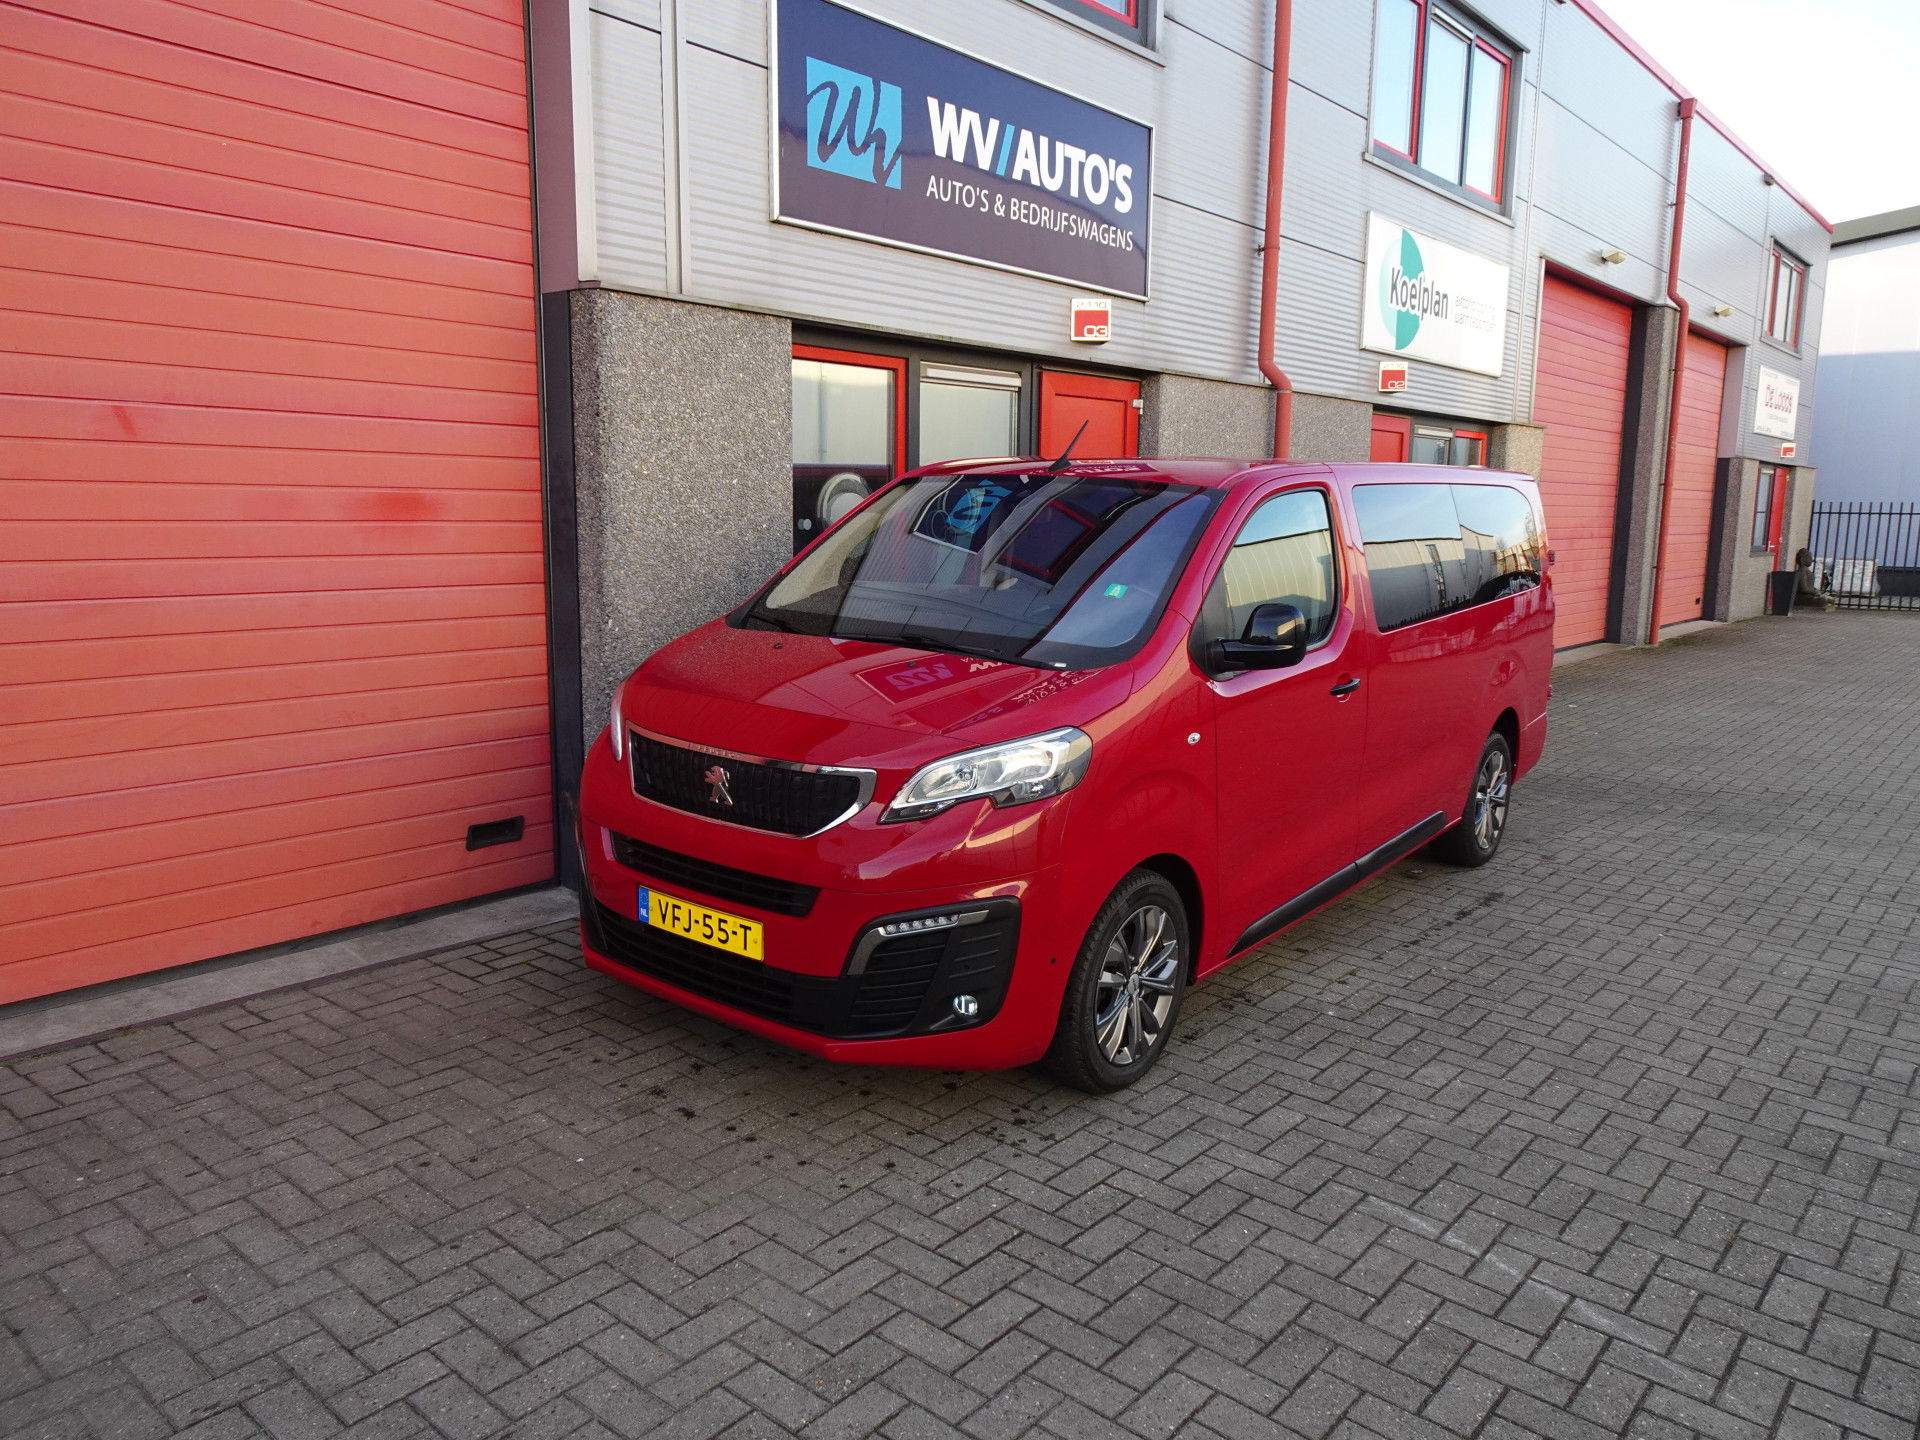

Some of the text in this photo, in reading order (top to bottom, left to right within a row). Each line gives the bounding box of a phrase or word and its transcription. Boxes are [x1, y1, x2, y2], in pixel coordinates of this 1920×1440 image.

[926, 175, 1134, 251] AUTO'S & BEDRIJFSWAGENS
[1389, 266, 1449, 320] Koelplan
[640, 907, 649, 918] NL
[658, 898, 752, 951] VFJ-55-T
